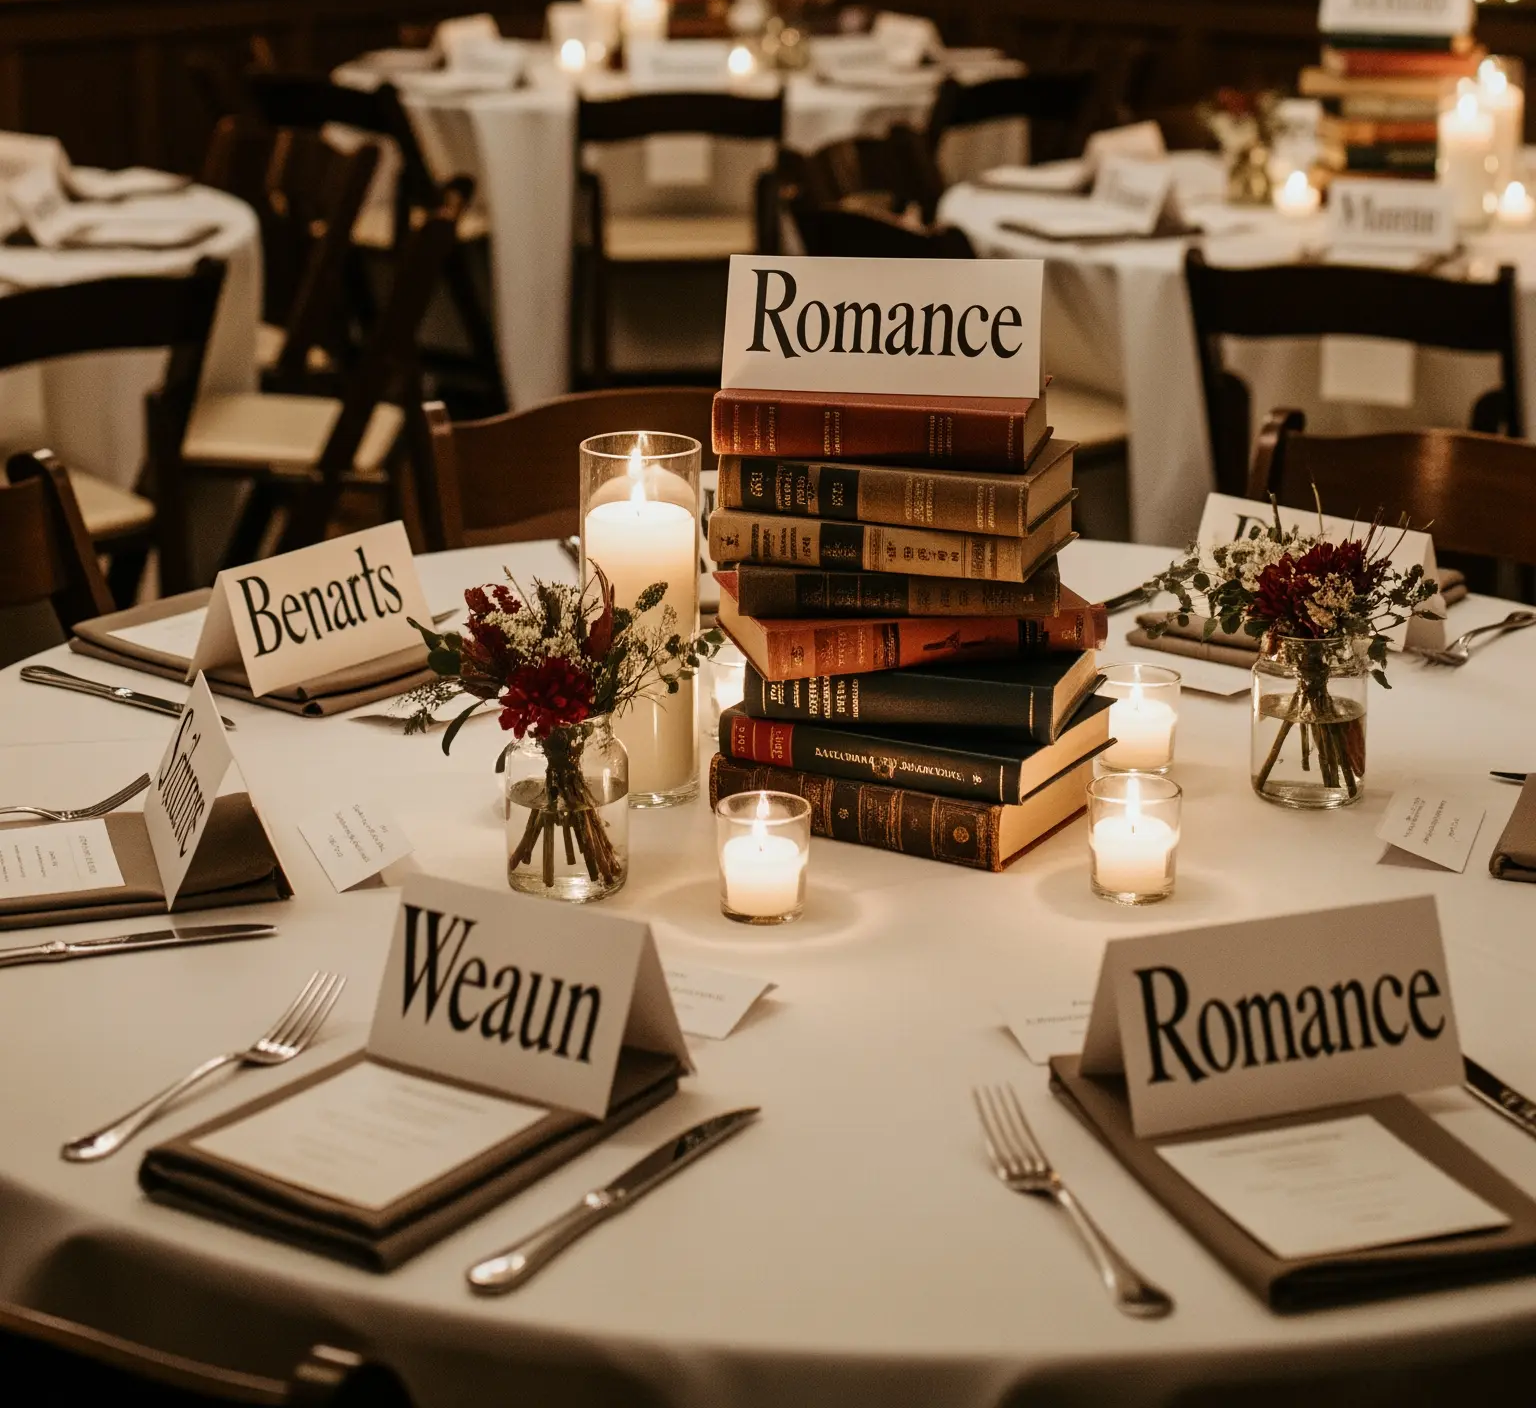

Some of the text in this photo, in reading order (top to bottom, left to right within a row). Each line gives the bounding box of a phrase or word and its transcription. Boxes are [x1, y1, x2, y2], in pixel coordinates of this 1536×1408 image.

[746, 268, 1023, 359] Romance
[236, 545, 403, 658] Benarts
[402, 903, 602, 1064] Weaun
[1133, 965, 1446, 1085] Romance
